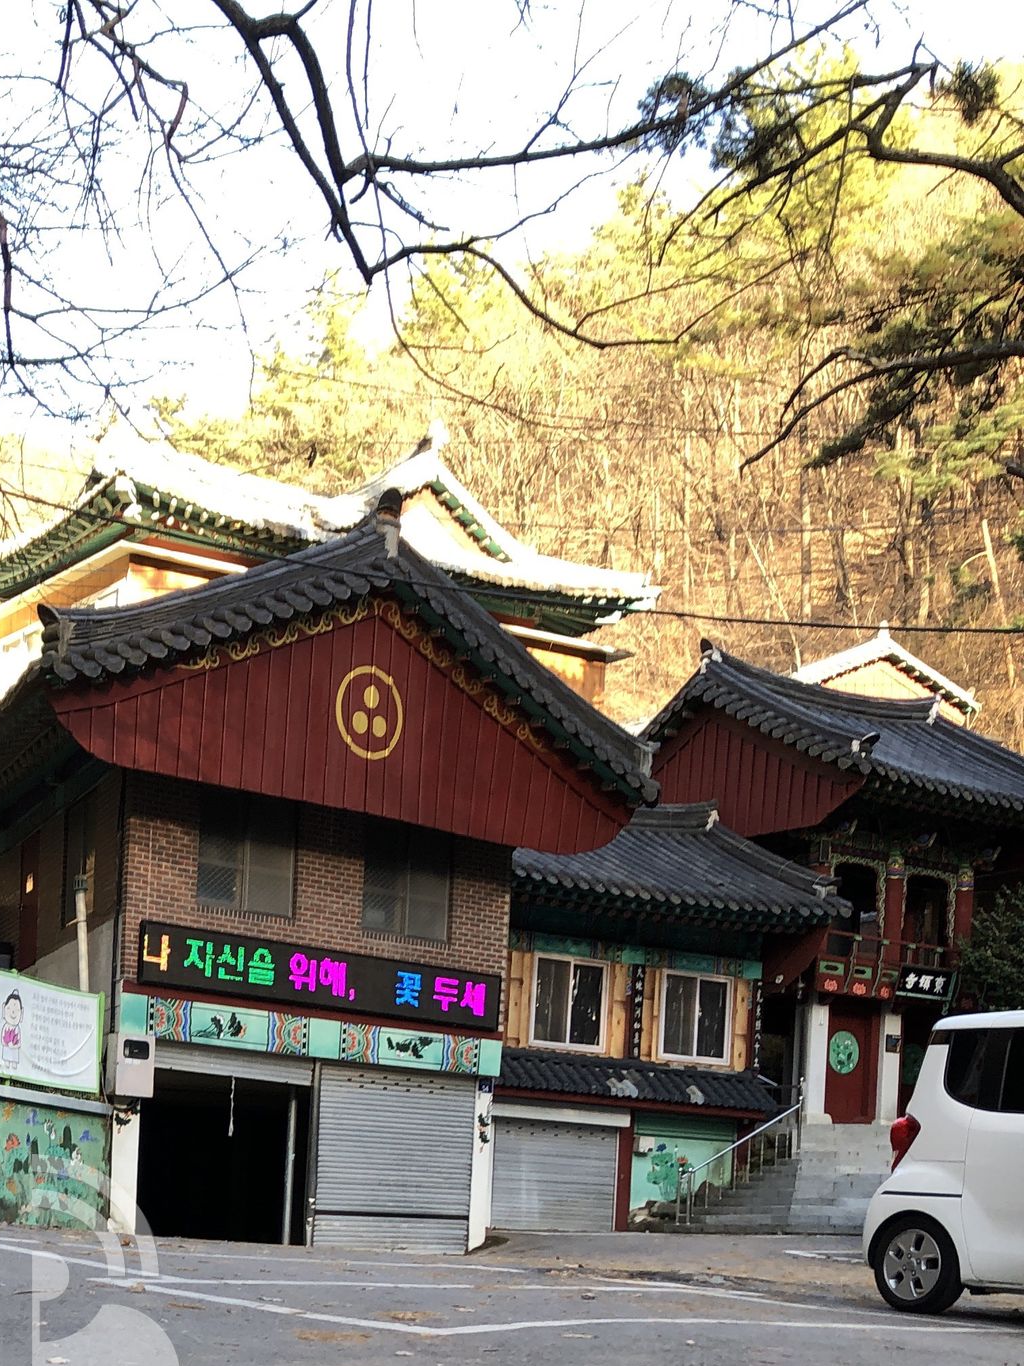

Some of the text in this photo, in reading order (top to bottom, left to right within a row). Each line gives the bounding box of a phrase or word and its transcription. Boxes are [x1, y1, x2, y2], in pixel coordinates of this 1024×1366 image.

[143, 933, 486, 1017] 나 자신을 위해, 꽃 두세
